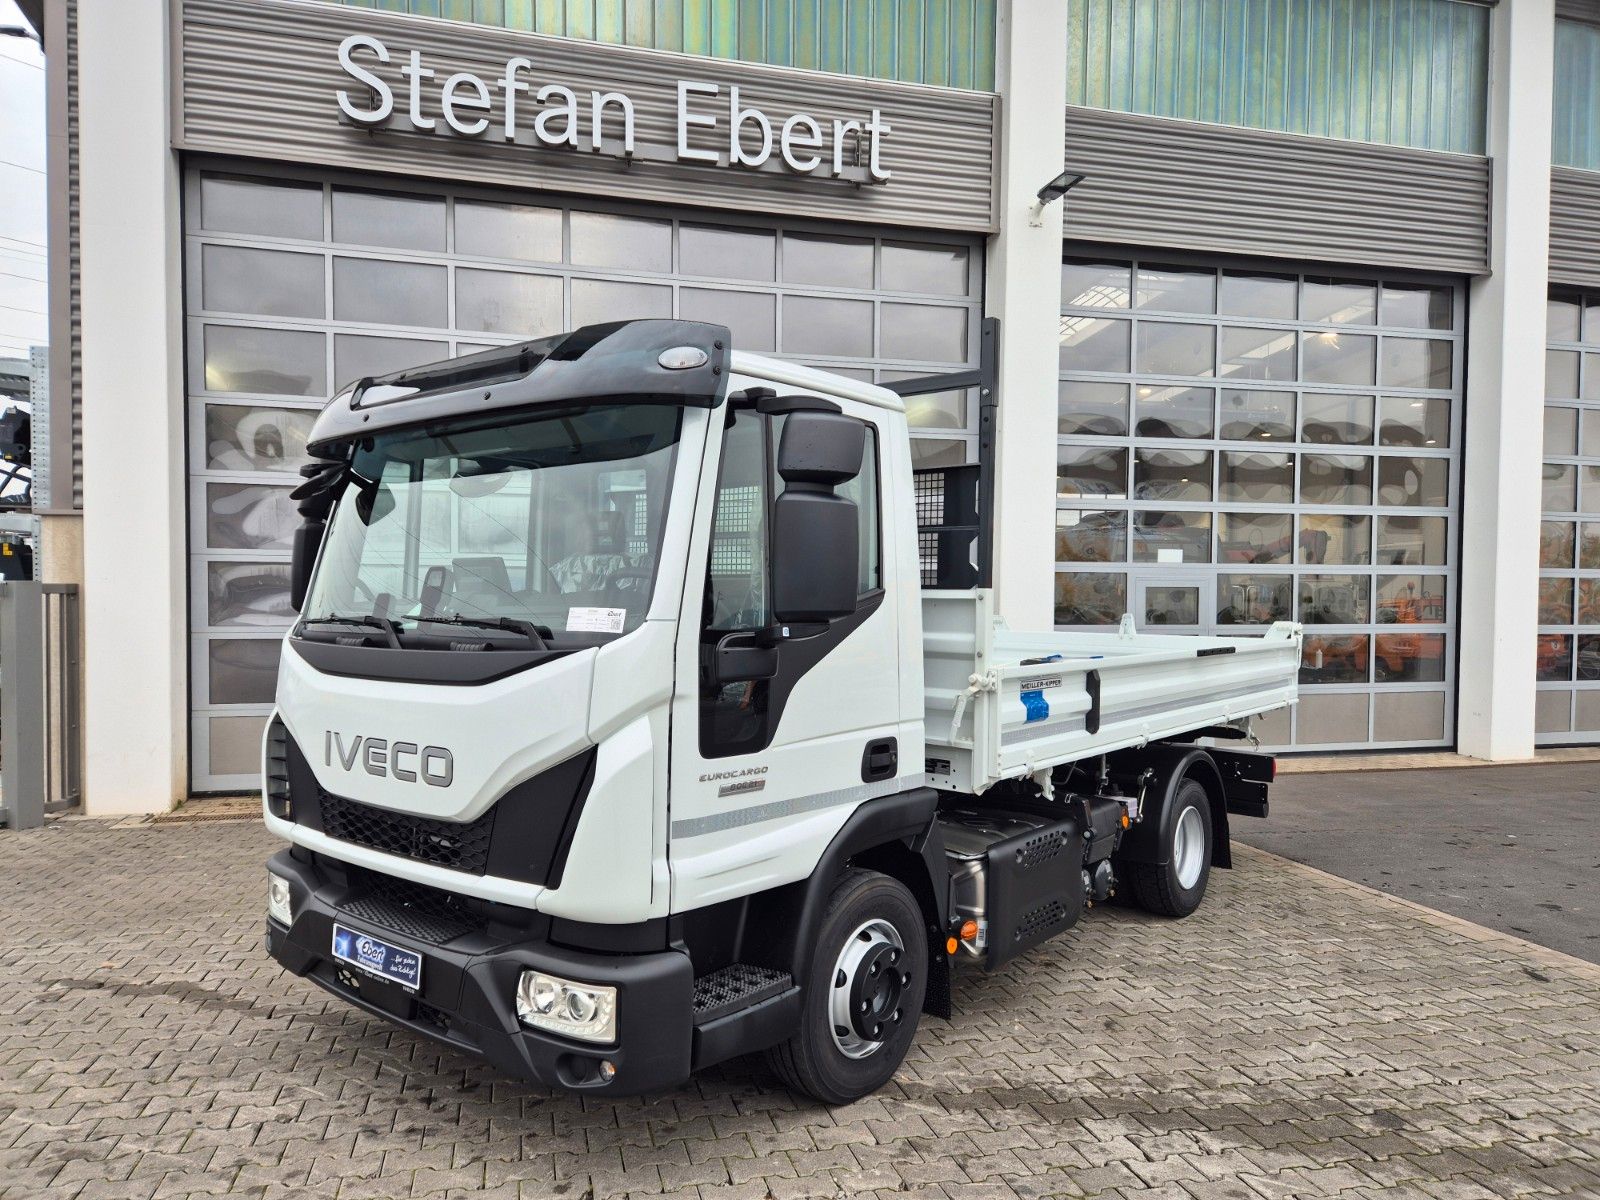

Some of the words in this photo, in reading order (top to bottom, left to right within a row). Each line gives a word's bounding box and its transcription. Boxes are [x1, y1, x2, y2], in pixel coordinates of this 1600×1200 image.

[336, 35, 634, 156] Stefan
[677, 80, 891, 184] Ebert
[1021, 680, 1061, 689] MEILLER-KIPPER
[325, 731, 453, 788] IVECO
[699, 767, 769, 782] EUROCARGO
[362, 941, 384, 960] Ebert
